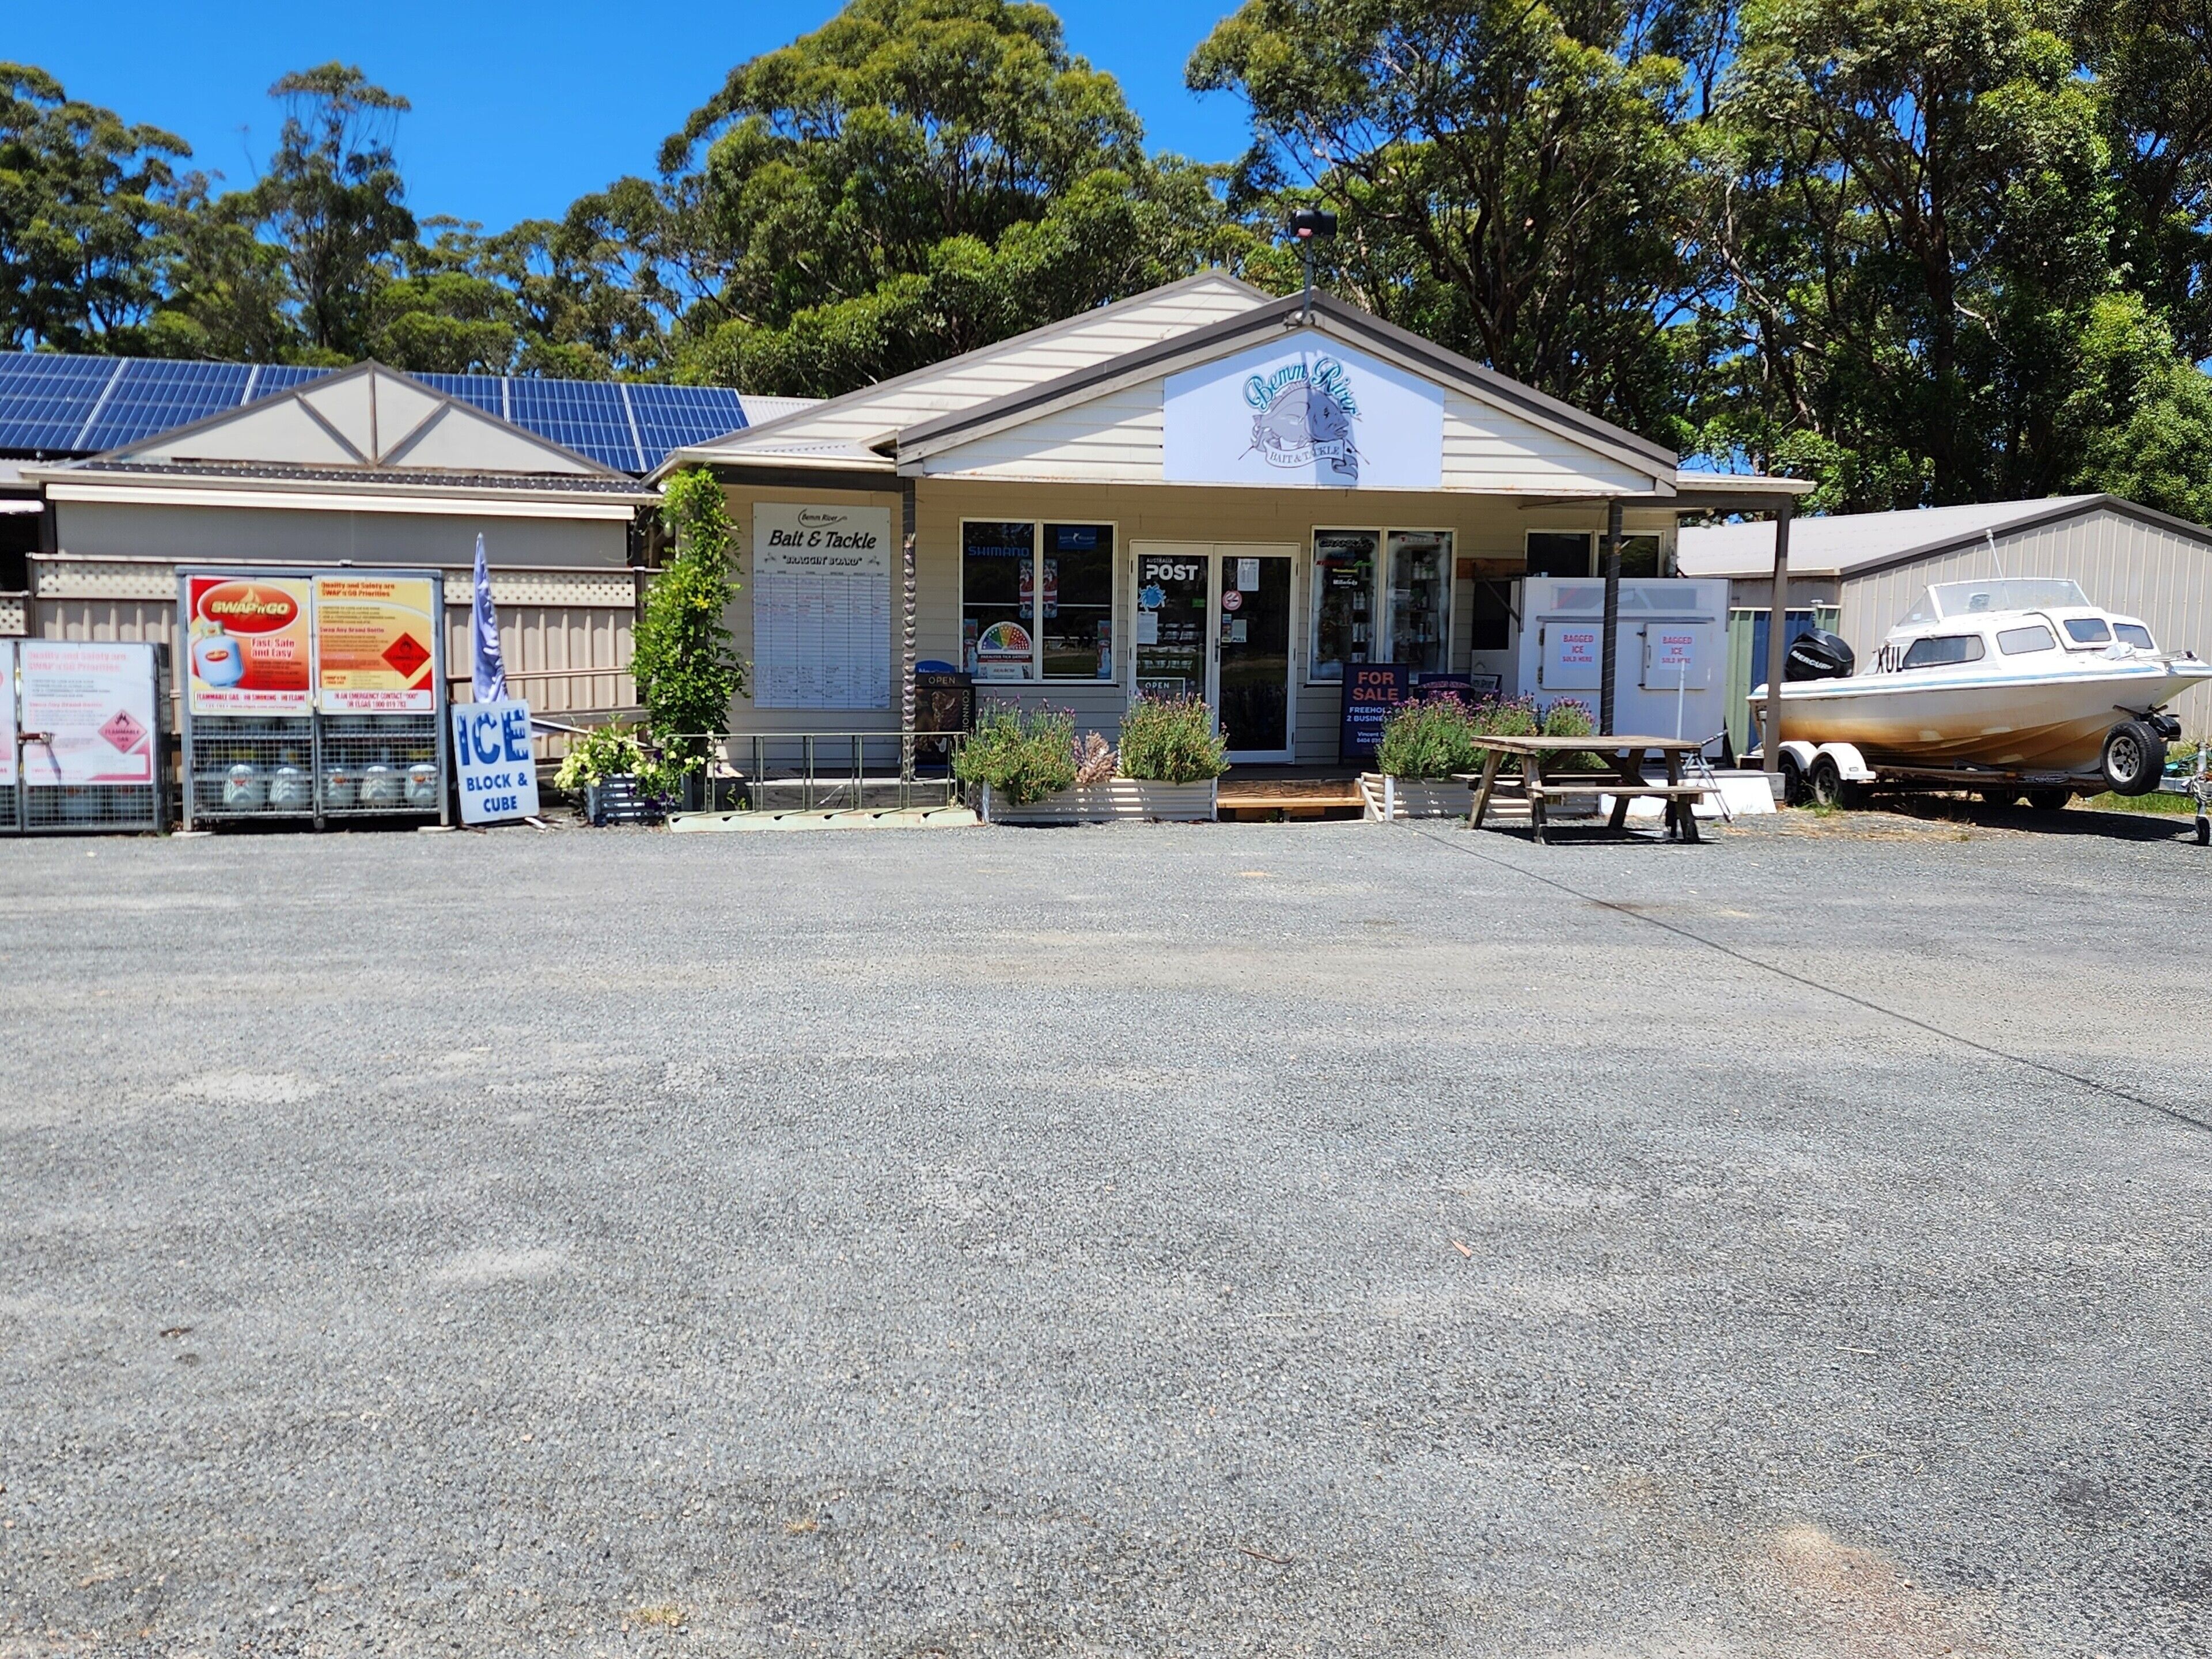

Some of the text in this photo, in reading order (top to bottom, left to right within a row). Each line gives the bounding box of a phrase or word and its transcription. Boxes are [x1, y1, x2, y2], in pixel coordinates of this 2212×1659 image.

[1244, 357, 1358, 415] Bemm River
[1270, 452, 1292, 463] BAIT
[1302, 446, 1340, 460] TACKLE
[768, 529, 877, 549] Bait & Tackle
[968, 546, 1029, 557] SHIMANO
[1146, 564, 1199, 581] POST
[1563, 635, 1594, 643] BAGGED
[1791, 650, 1834, 670] MERCURY
[928, 676, 956, 684] OPEN
[1145, 681, 1170, 690] OPEN
[1358, 672, 1395, 685] FOR
[1353, 688, 1399, 701] SALE
[456, 709, 529, 766] ICE
[466, 772, 528, 792] BLOCK &
[483, 795, 518, 813] CUBE
